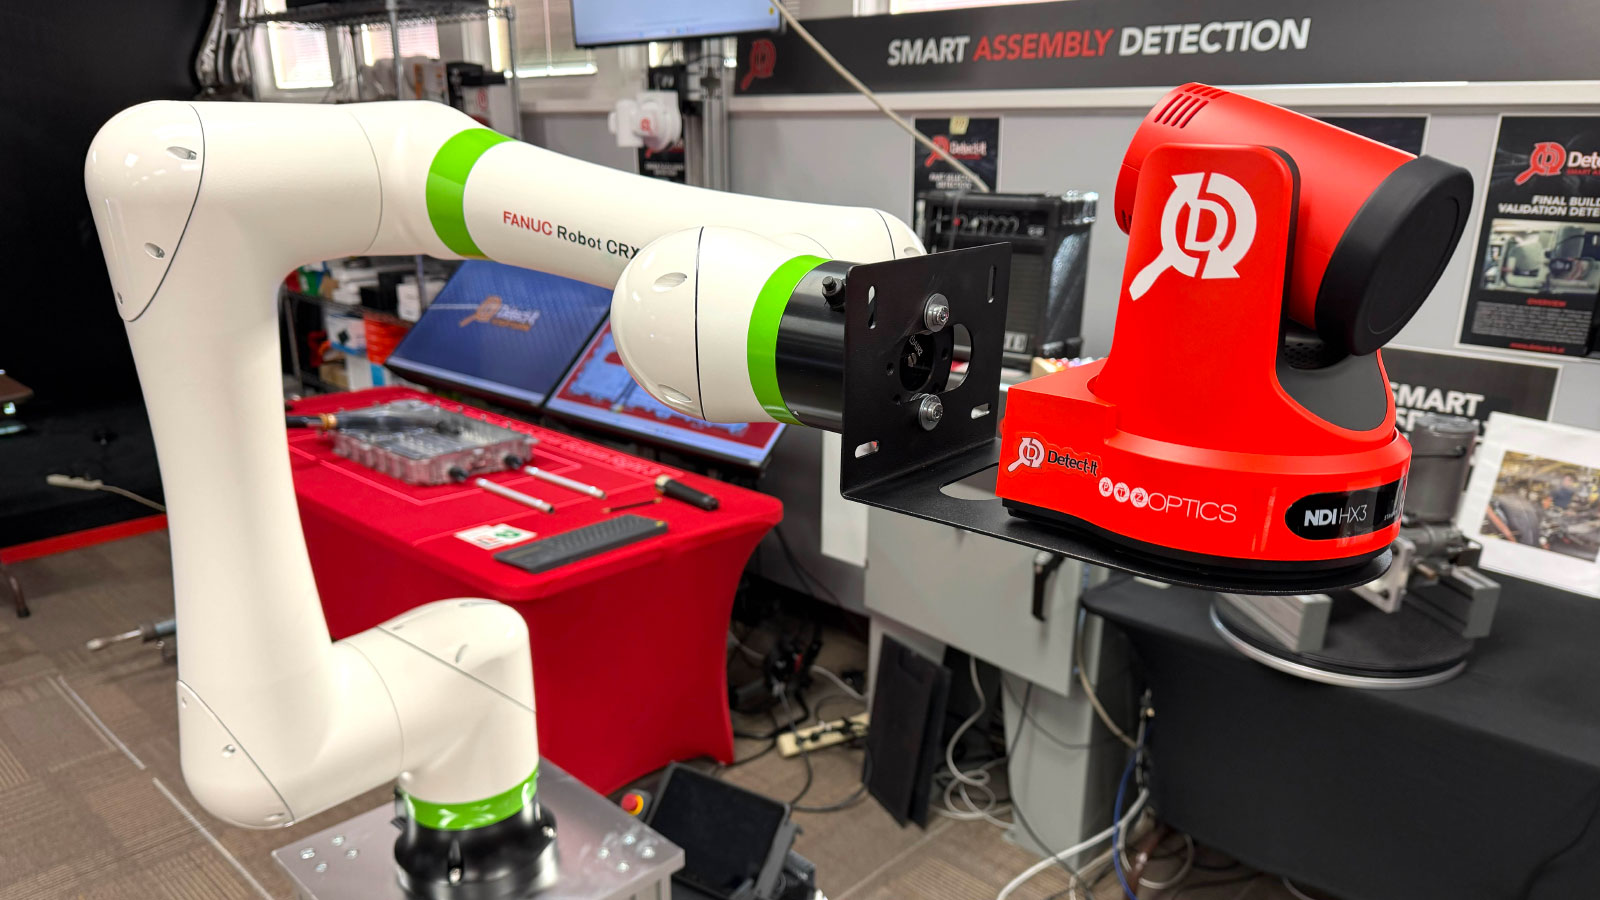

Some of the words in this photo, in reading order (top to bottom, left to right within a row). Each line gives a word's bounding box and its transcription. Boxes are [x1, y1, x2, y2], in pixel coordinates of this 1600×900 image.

[887, 36, 970, 66] SMART
[972, 28, 1114, 62] ASSEMBLY
[1119, 18, 1311, 56] DETECTION
[1498, 202, 1567, 216] VALIDATION
[1532, 194, 1567, 206] FINAL
[503, 210, 553, 237] FANUC
[557, 225, 601, 251] Robot
[1047, 450, 1098, 477] Detect-It
[1304, 508, 1338, 527] NDI
[1339, 504, 1368, 525] HX3
